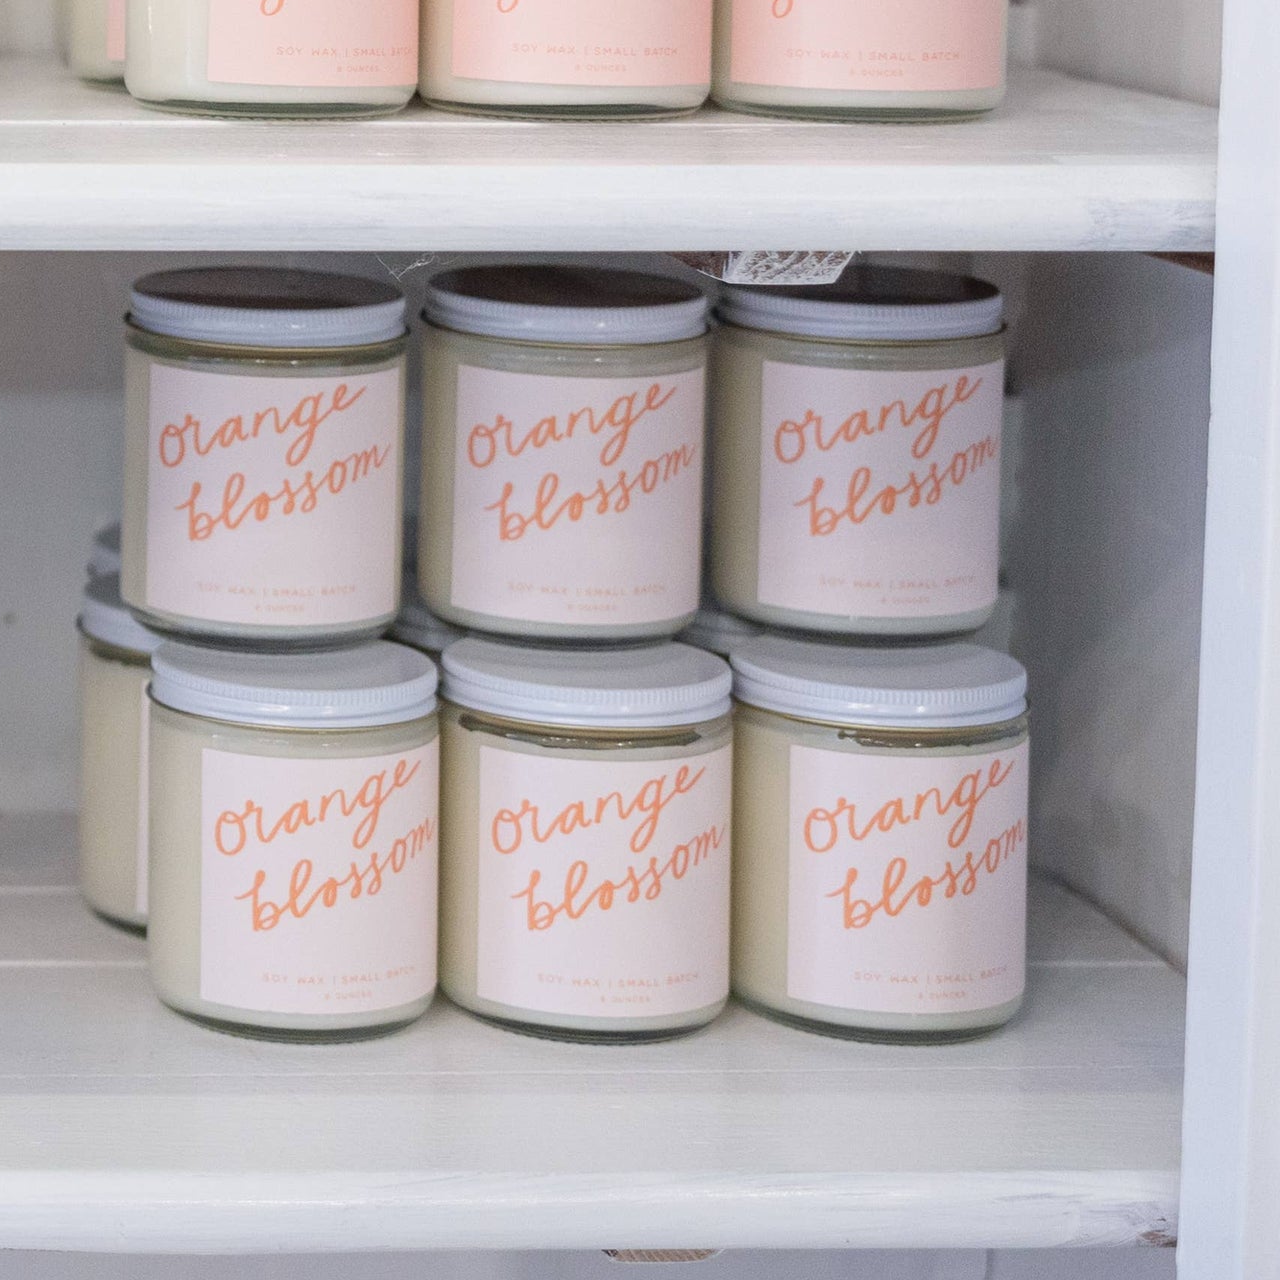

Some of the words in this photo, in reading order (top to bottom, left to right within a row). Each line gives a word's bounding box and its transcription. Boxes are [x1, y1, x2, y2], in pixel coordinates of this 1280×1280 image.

[158, 384, 366, 468] orange
[467, 384, 676, 469] orange
[773, 376, 981, 464] orange
[178, 442, 389, 541] blossom
[485, 444, 693, 541] blossom
[796, 435, 998, 536] blossom
[214, 760, 420, 856] orange
[491, 765, 705, 855] orange
[804, 759, 1014, 853] orange
[236, 818, 436, 932] blossom
[513, 825, 725, 931] blossom
[828, 818, 1025, 930] blossom
